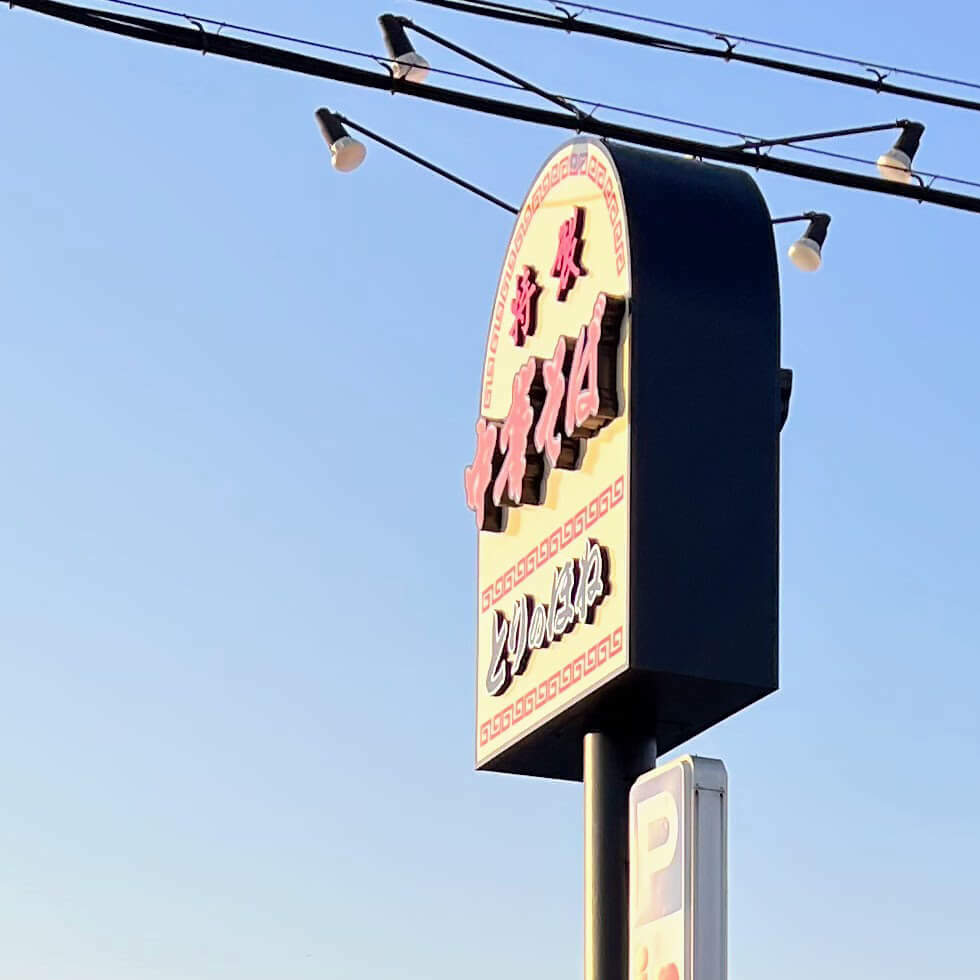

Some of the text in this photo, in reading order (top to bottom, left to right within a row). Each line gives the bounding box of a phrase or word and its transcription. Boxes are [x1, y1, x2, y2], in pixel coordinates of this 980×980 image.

[464, 292, 616, 530] 中華そば
[484, 538, 609, 696] とりのほね
[635, 790, 679, 926] P
